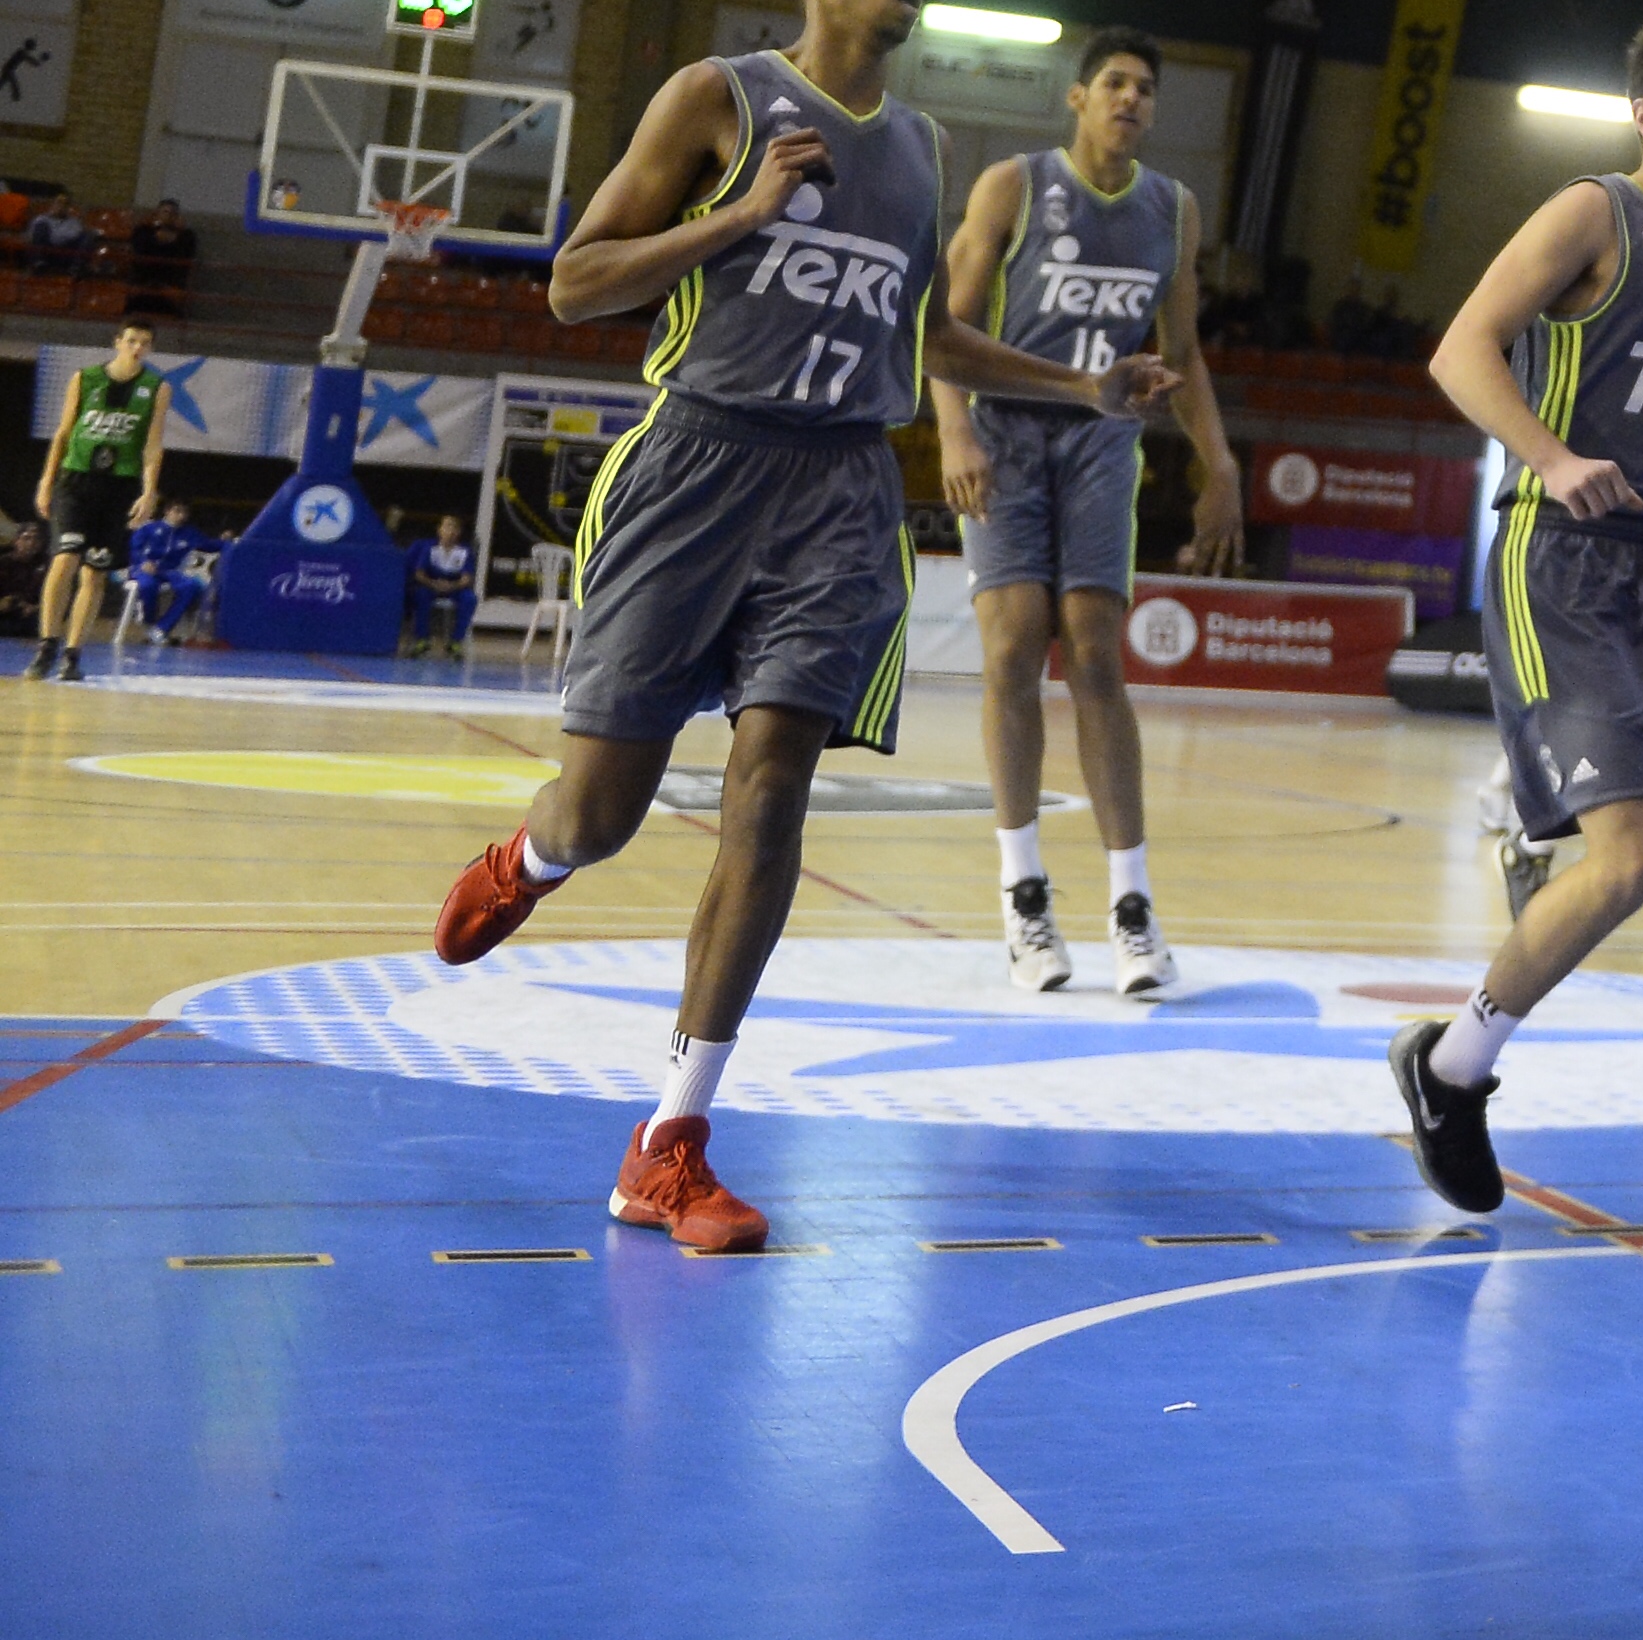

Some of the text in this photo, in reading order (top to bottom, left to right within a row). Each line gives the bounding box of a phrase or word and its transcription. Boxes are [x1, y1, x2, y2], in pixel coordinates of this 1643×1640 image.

[1375, 21, 1447, 226] #boost
[793, 334, 863, 407] 17
[1205, 611, 1333, 643] Diputació
[1205, 636, 1332, 666] Barcelona
